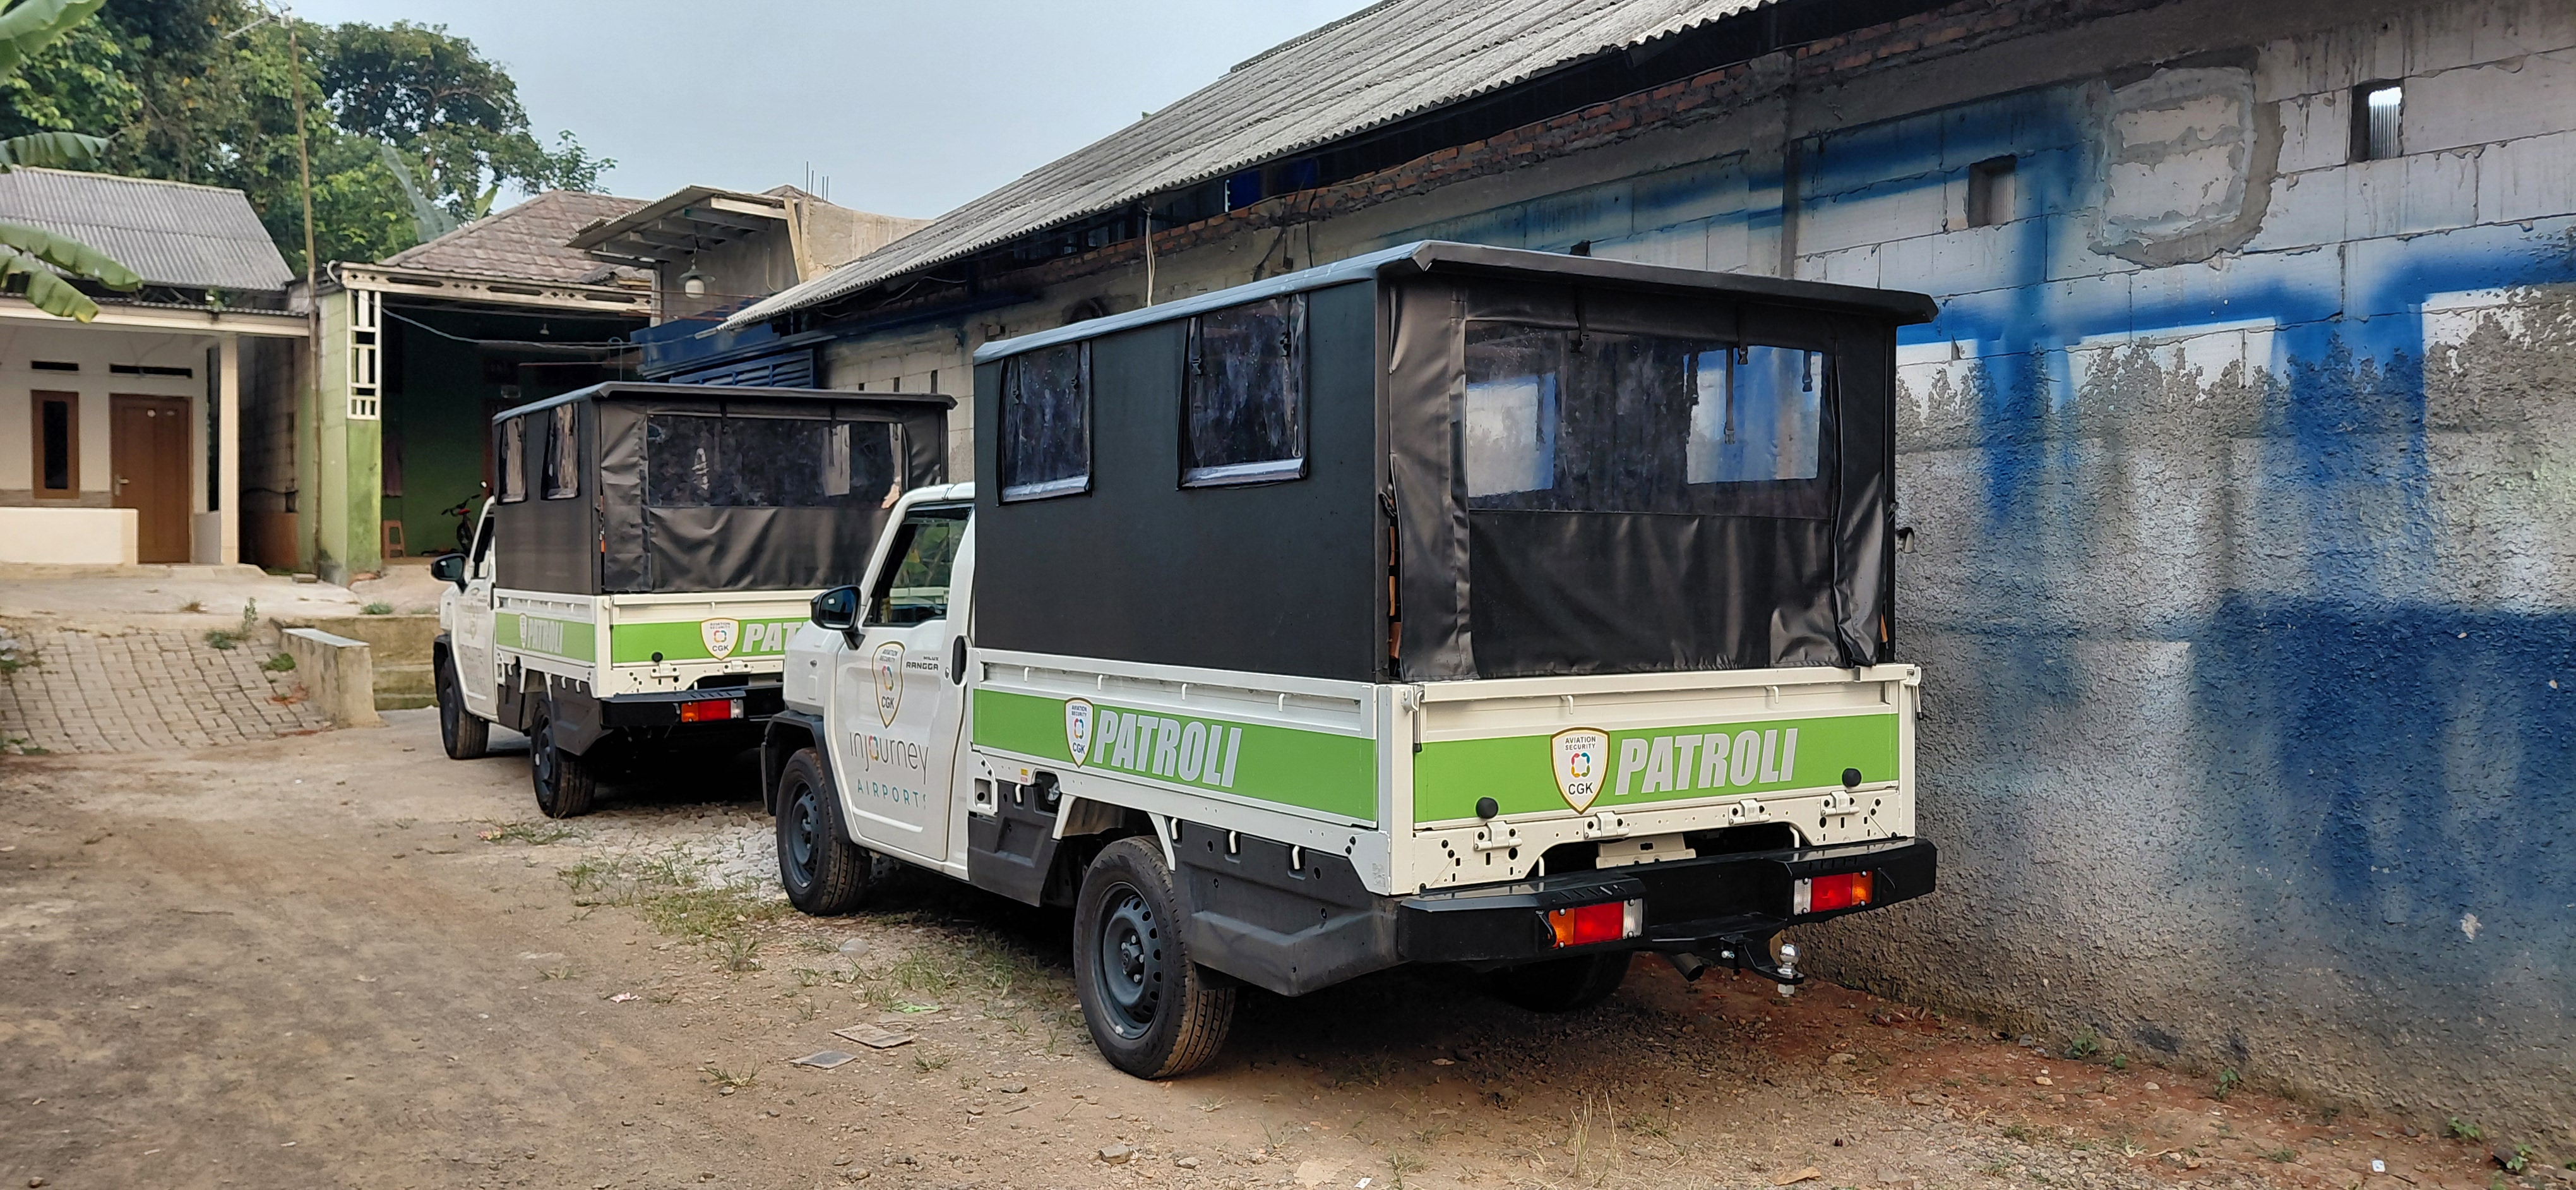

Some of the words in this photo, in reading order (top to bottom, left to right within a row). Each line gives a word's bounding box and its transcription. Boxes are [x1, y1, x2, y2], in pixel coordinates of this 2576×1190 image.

[742, 622, 806, 653] PAT
[906, 661, 939, 671] RANGGA
[881, 695, 895, 709] CGK
[1565, 736, 1596, 744] AVIATION
[1073, 742, 1086, 755] CGK
[1093, 709, 1243, 788] PATROLI
[849, 732, 929, 785] injourney
[1614, 728, 1799, 796] PATROLI
[1568, 782, 1593, 795] CGK
